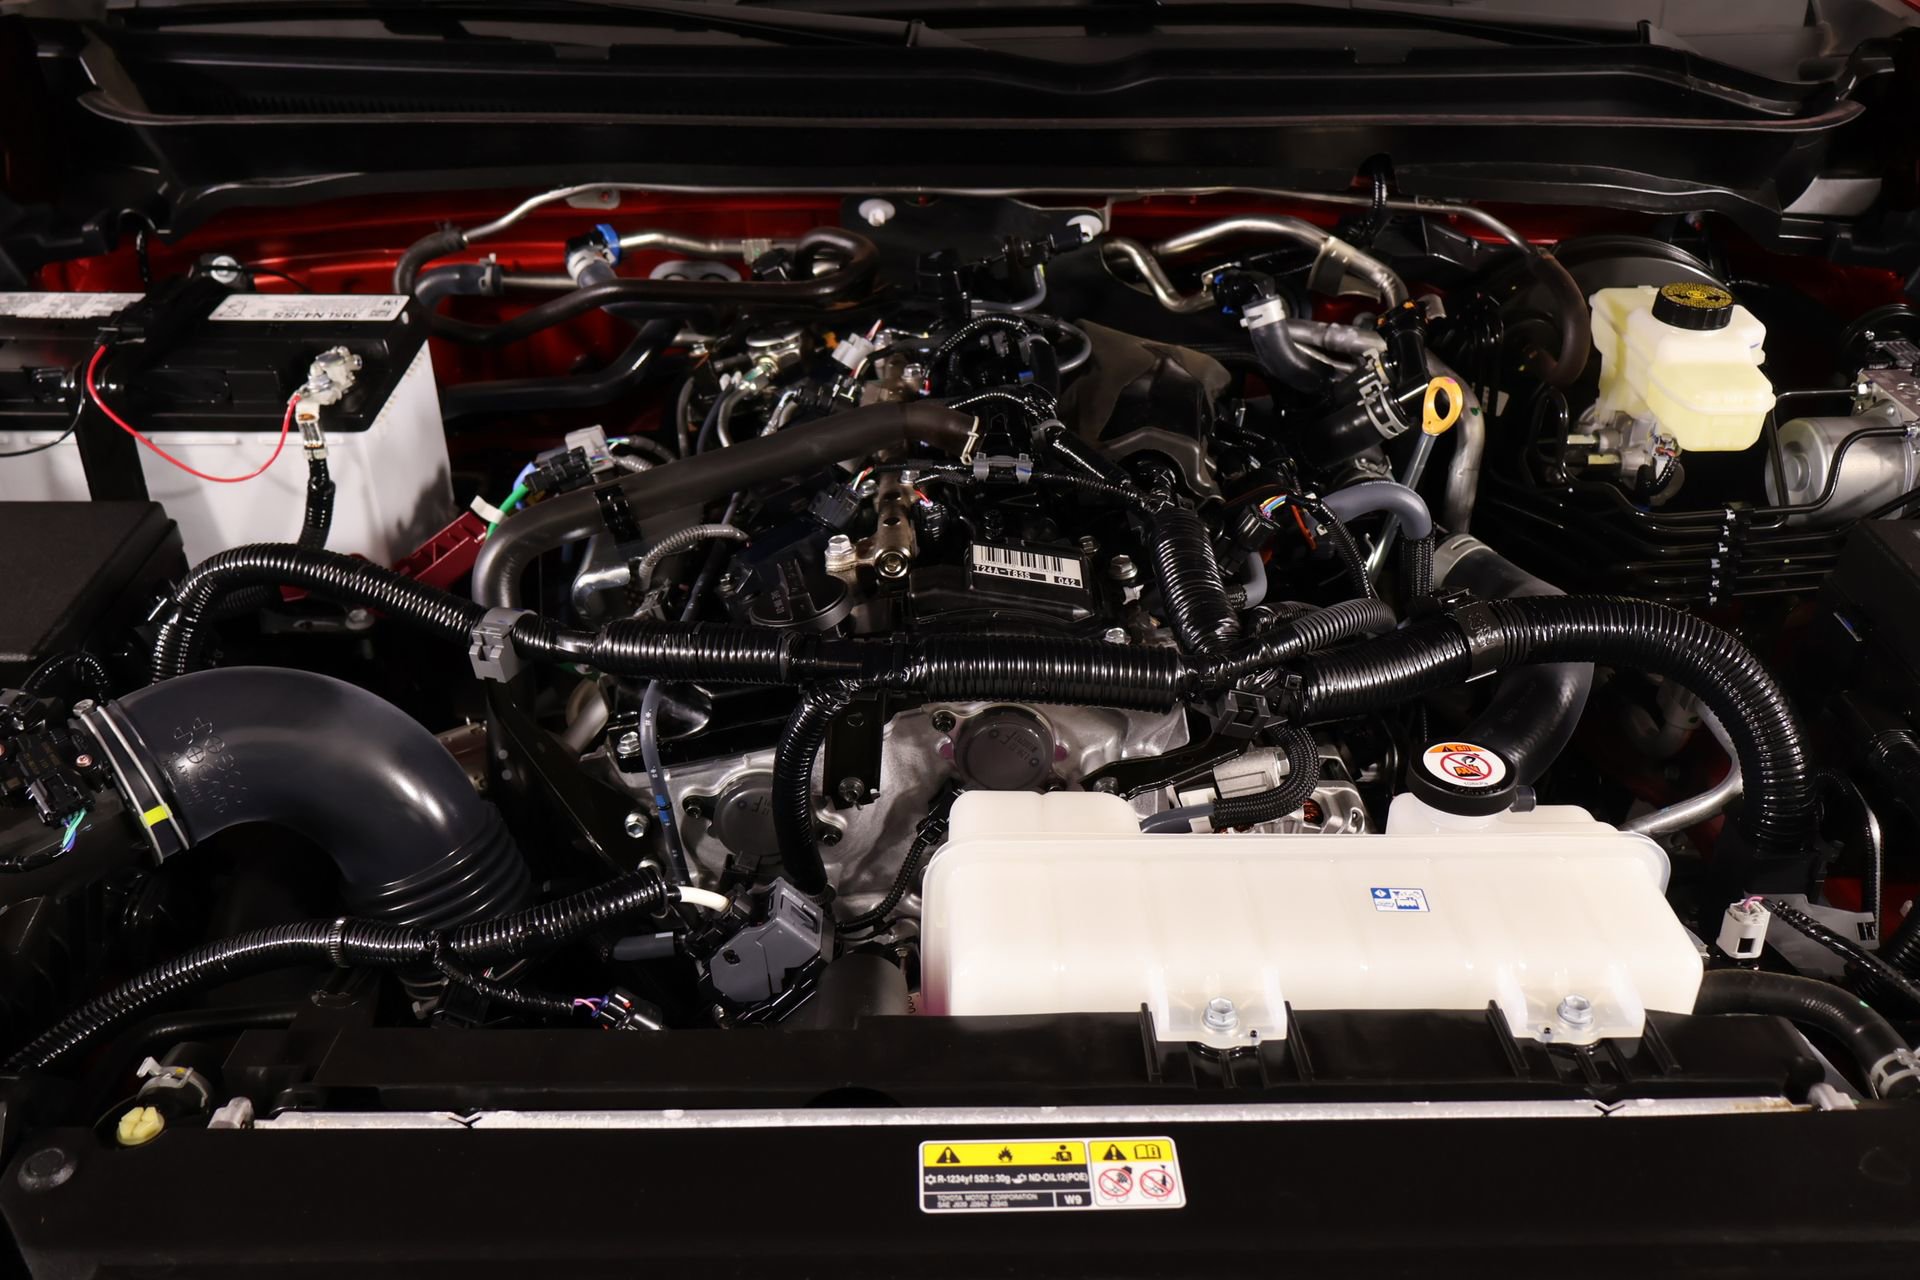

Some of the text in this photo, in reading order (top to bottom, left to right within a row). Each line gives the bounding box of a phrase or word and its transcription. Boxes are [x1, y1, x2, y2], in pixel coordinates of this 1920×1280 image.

[937, 1174, 973, 1185] R-1234yf
[1028, 1172, 1088, 1183] ND-OIL12(POE)
[937, 1194, 963, 1202] TOYOTA
[991, 1193, 1038, 1201] CORPORATION
[1064, 1194, 1083, 1205] W9
